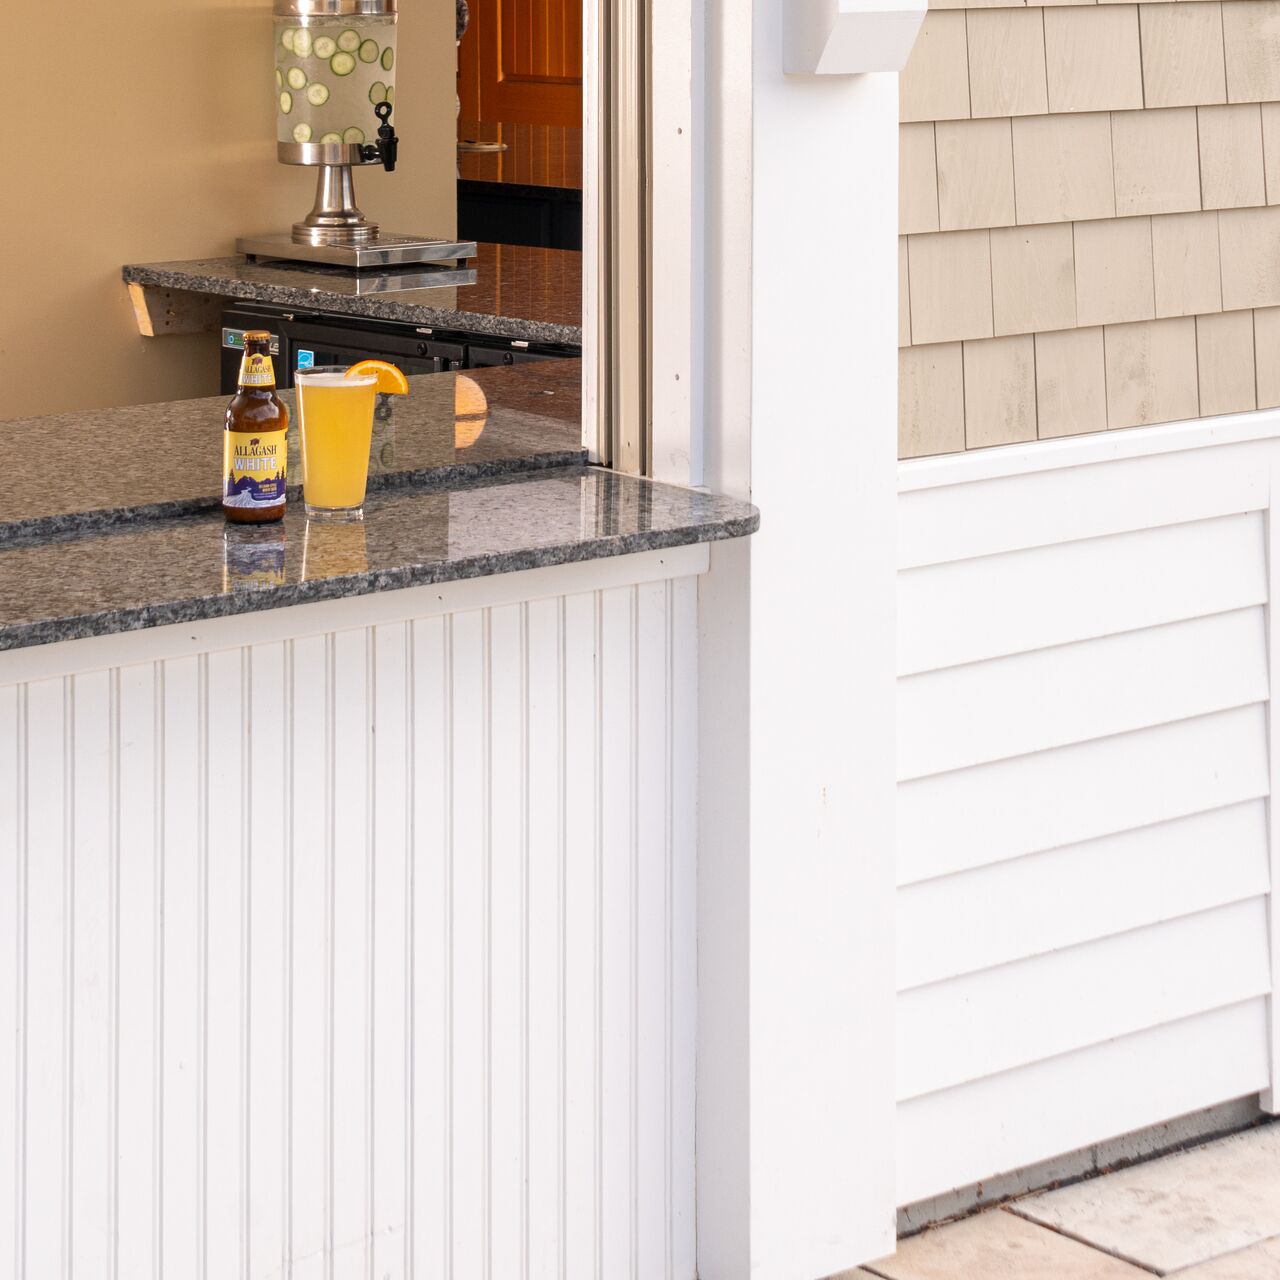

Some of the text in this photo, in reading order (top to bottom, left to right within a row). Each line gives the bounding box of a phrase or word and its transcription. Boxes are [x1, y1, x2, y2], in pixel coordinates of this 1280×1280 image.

[242, 373, 273, 385] WHITE
[233, 444, 277, 456] ALLAGASH
[233, 456, 278, 471] WHITE
